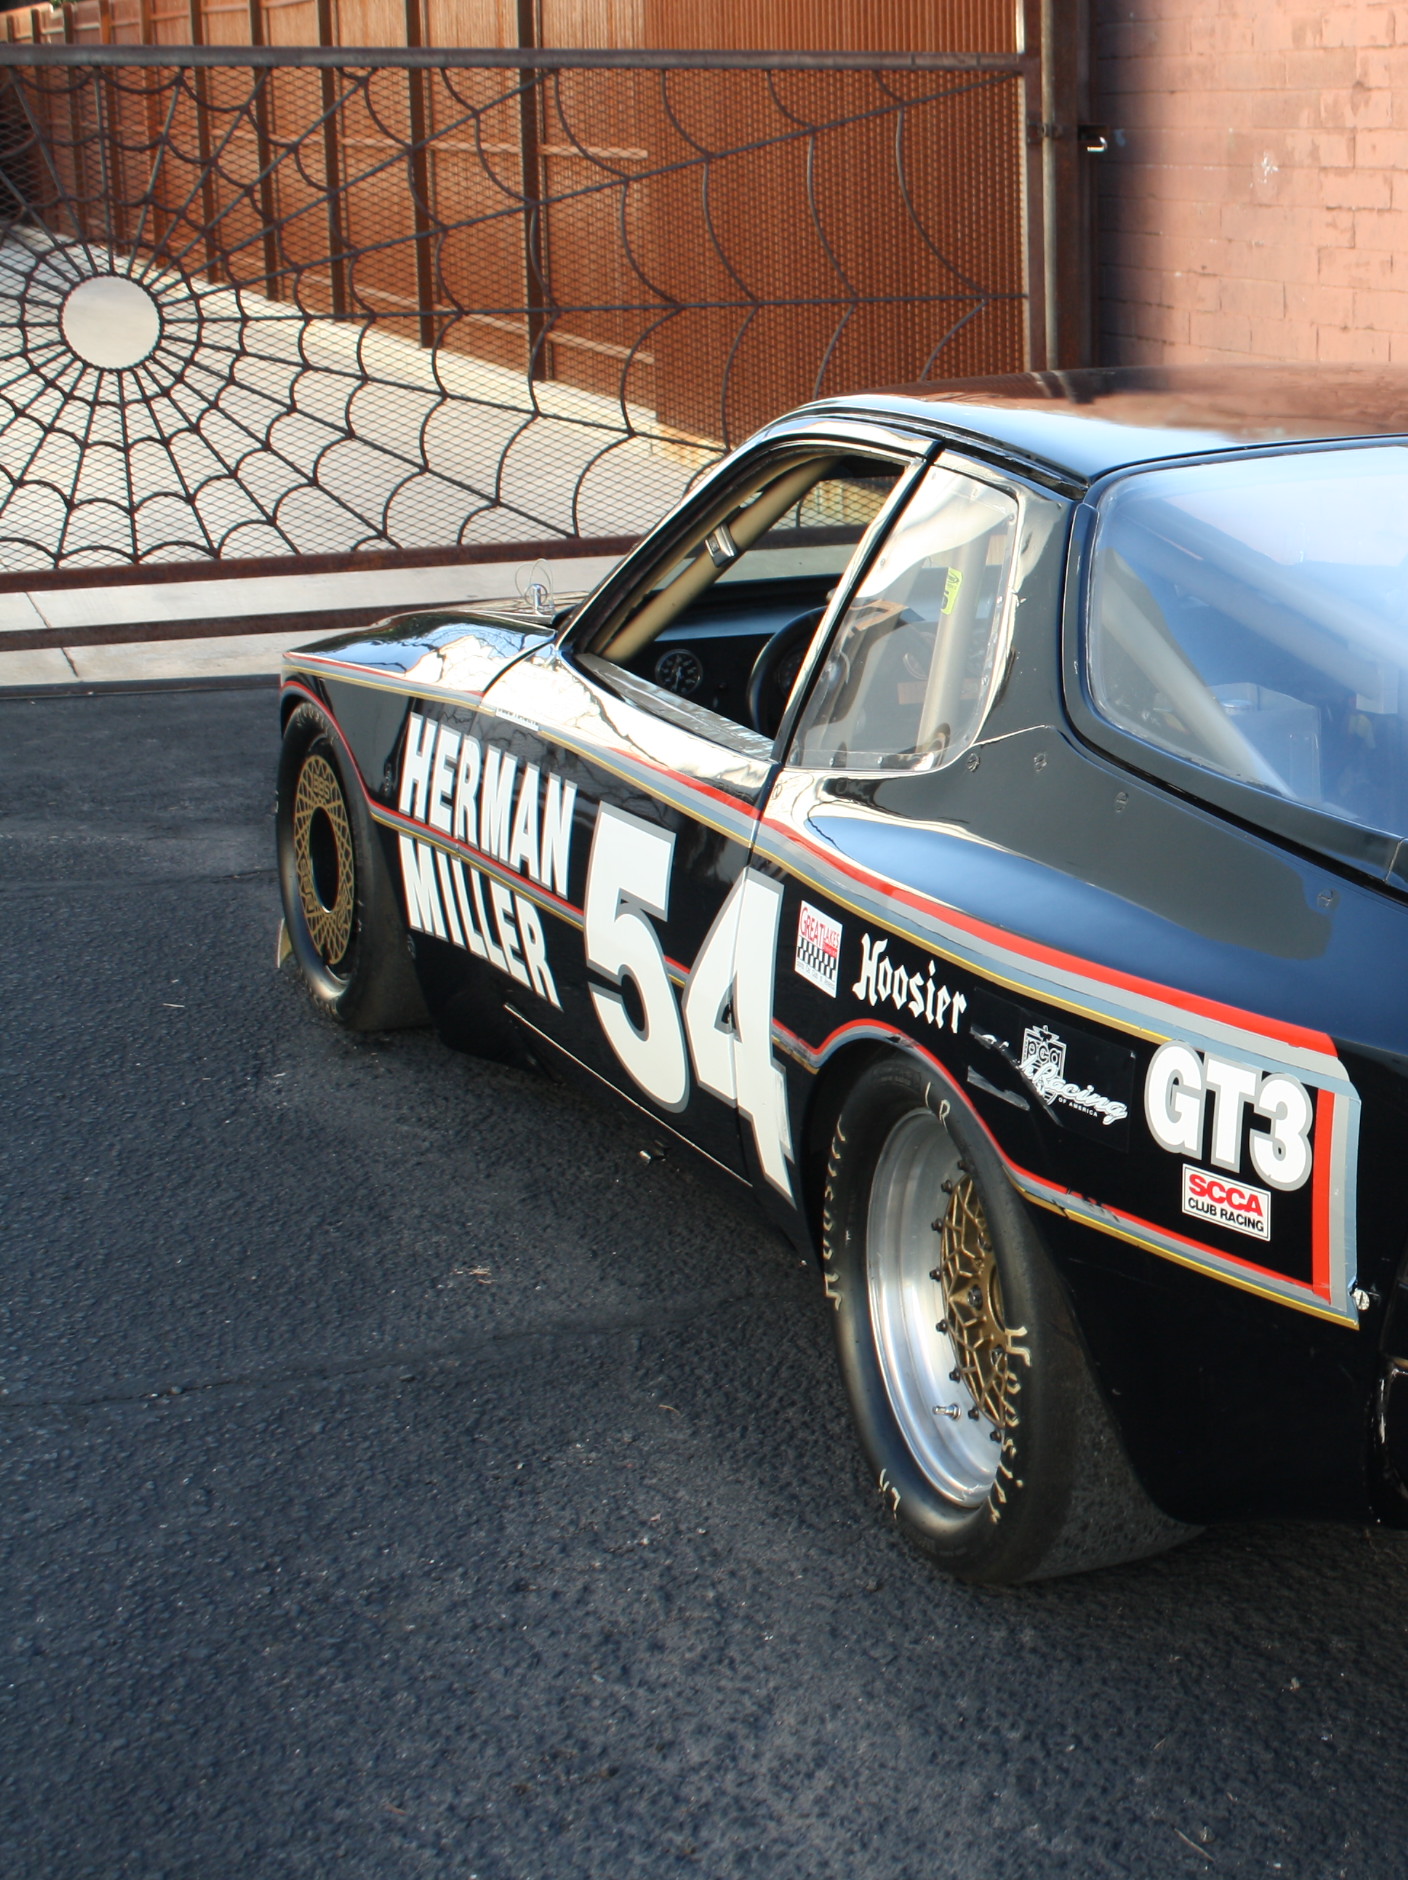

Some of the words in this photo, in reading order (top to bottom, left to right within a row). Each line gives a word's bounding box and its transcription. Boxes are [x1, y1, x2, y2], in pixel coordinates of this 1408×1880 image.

[399, 711, 577, 901] HERMAN
[398, 831, 564, 1013] MILLER
[800, 907, 826, 950] GREAT
[583, 800, 798, 1211] 54
[852, 932, 967, 1034] Hoosier
[1033, 1062, 1128, 1126] Racing
[1144, 1039, 1313, 1192] GT3
[1188, 1173, 1264, 1218] SCCA
[1188, 1197, 1217, 1217] CLUB
[1220, 1207, 1264, 1233] RACING
